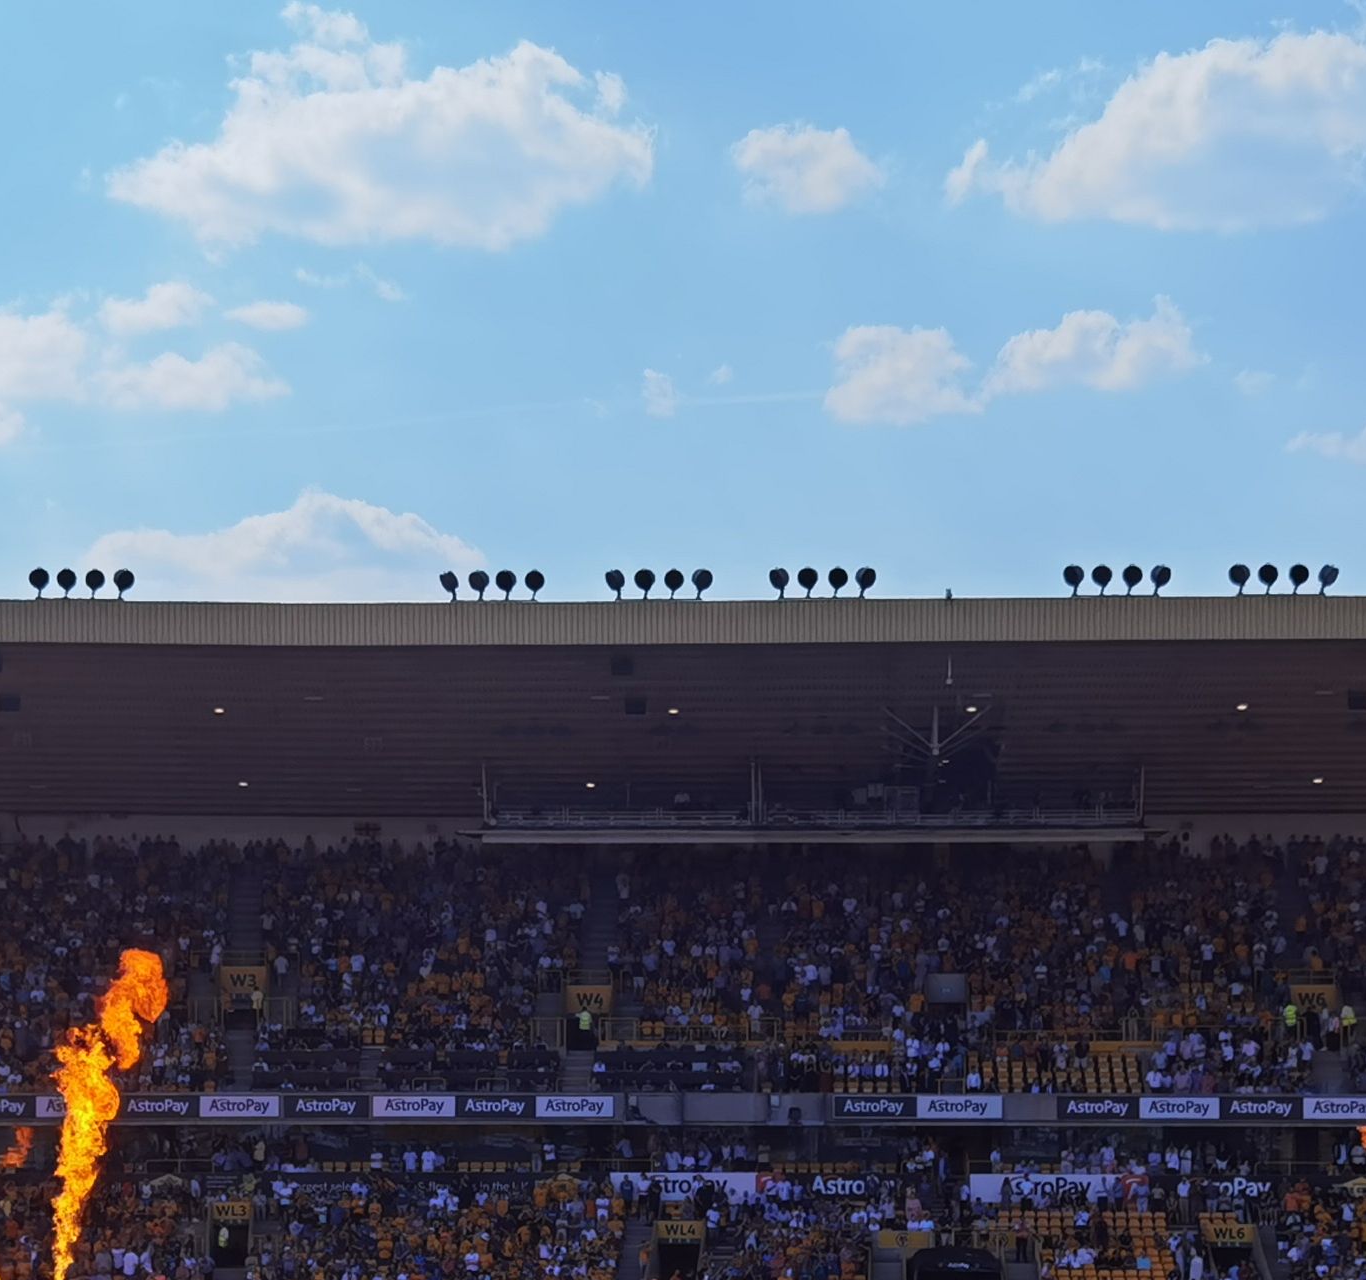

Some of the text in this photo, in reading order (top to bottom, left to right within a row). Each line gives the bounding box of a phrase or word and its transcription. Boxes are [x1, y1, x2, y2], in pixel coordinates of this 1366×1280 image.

[576, 993, 604, 1007] W4
[1298, 993, 1325, 1007] W6
[127, 1099, 189, 1116] AstroPay
[209, 1099, 270, 1116] AstroPay
[295, 1099, 356, 1115] AstroPay
[385, 1098, 444, 1115] AstroPay
[464, 1098, 525, 1115] AstroPay
[545, 1098, 604, 1115] AstroPay
[843, 1098, 904, 1115] AstroPay
[928, 1099, 988, 1115] AstroPay
[1066, 1099, 1128, 1115] AstroPay
[1149, 1099, 1210, 1115] AstroPay
[1229, 1099, 1292, 1116] AstroPay
[216, 1205, 247, 1217] WL3
[665, 1224, 695, 1235] WL4
[1214, 1227, 1245, 1239] WL6
